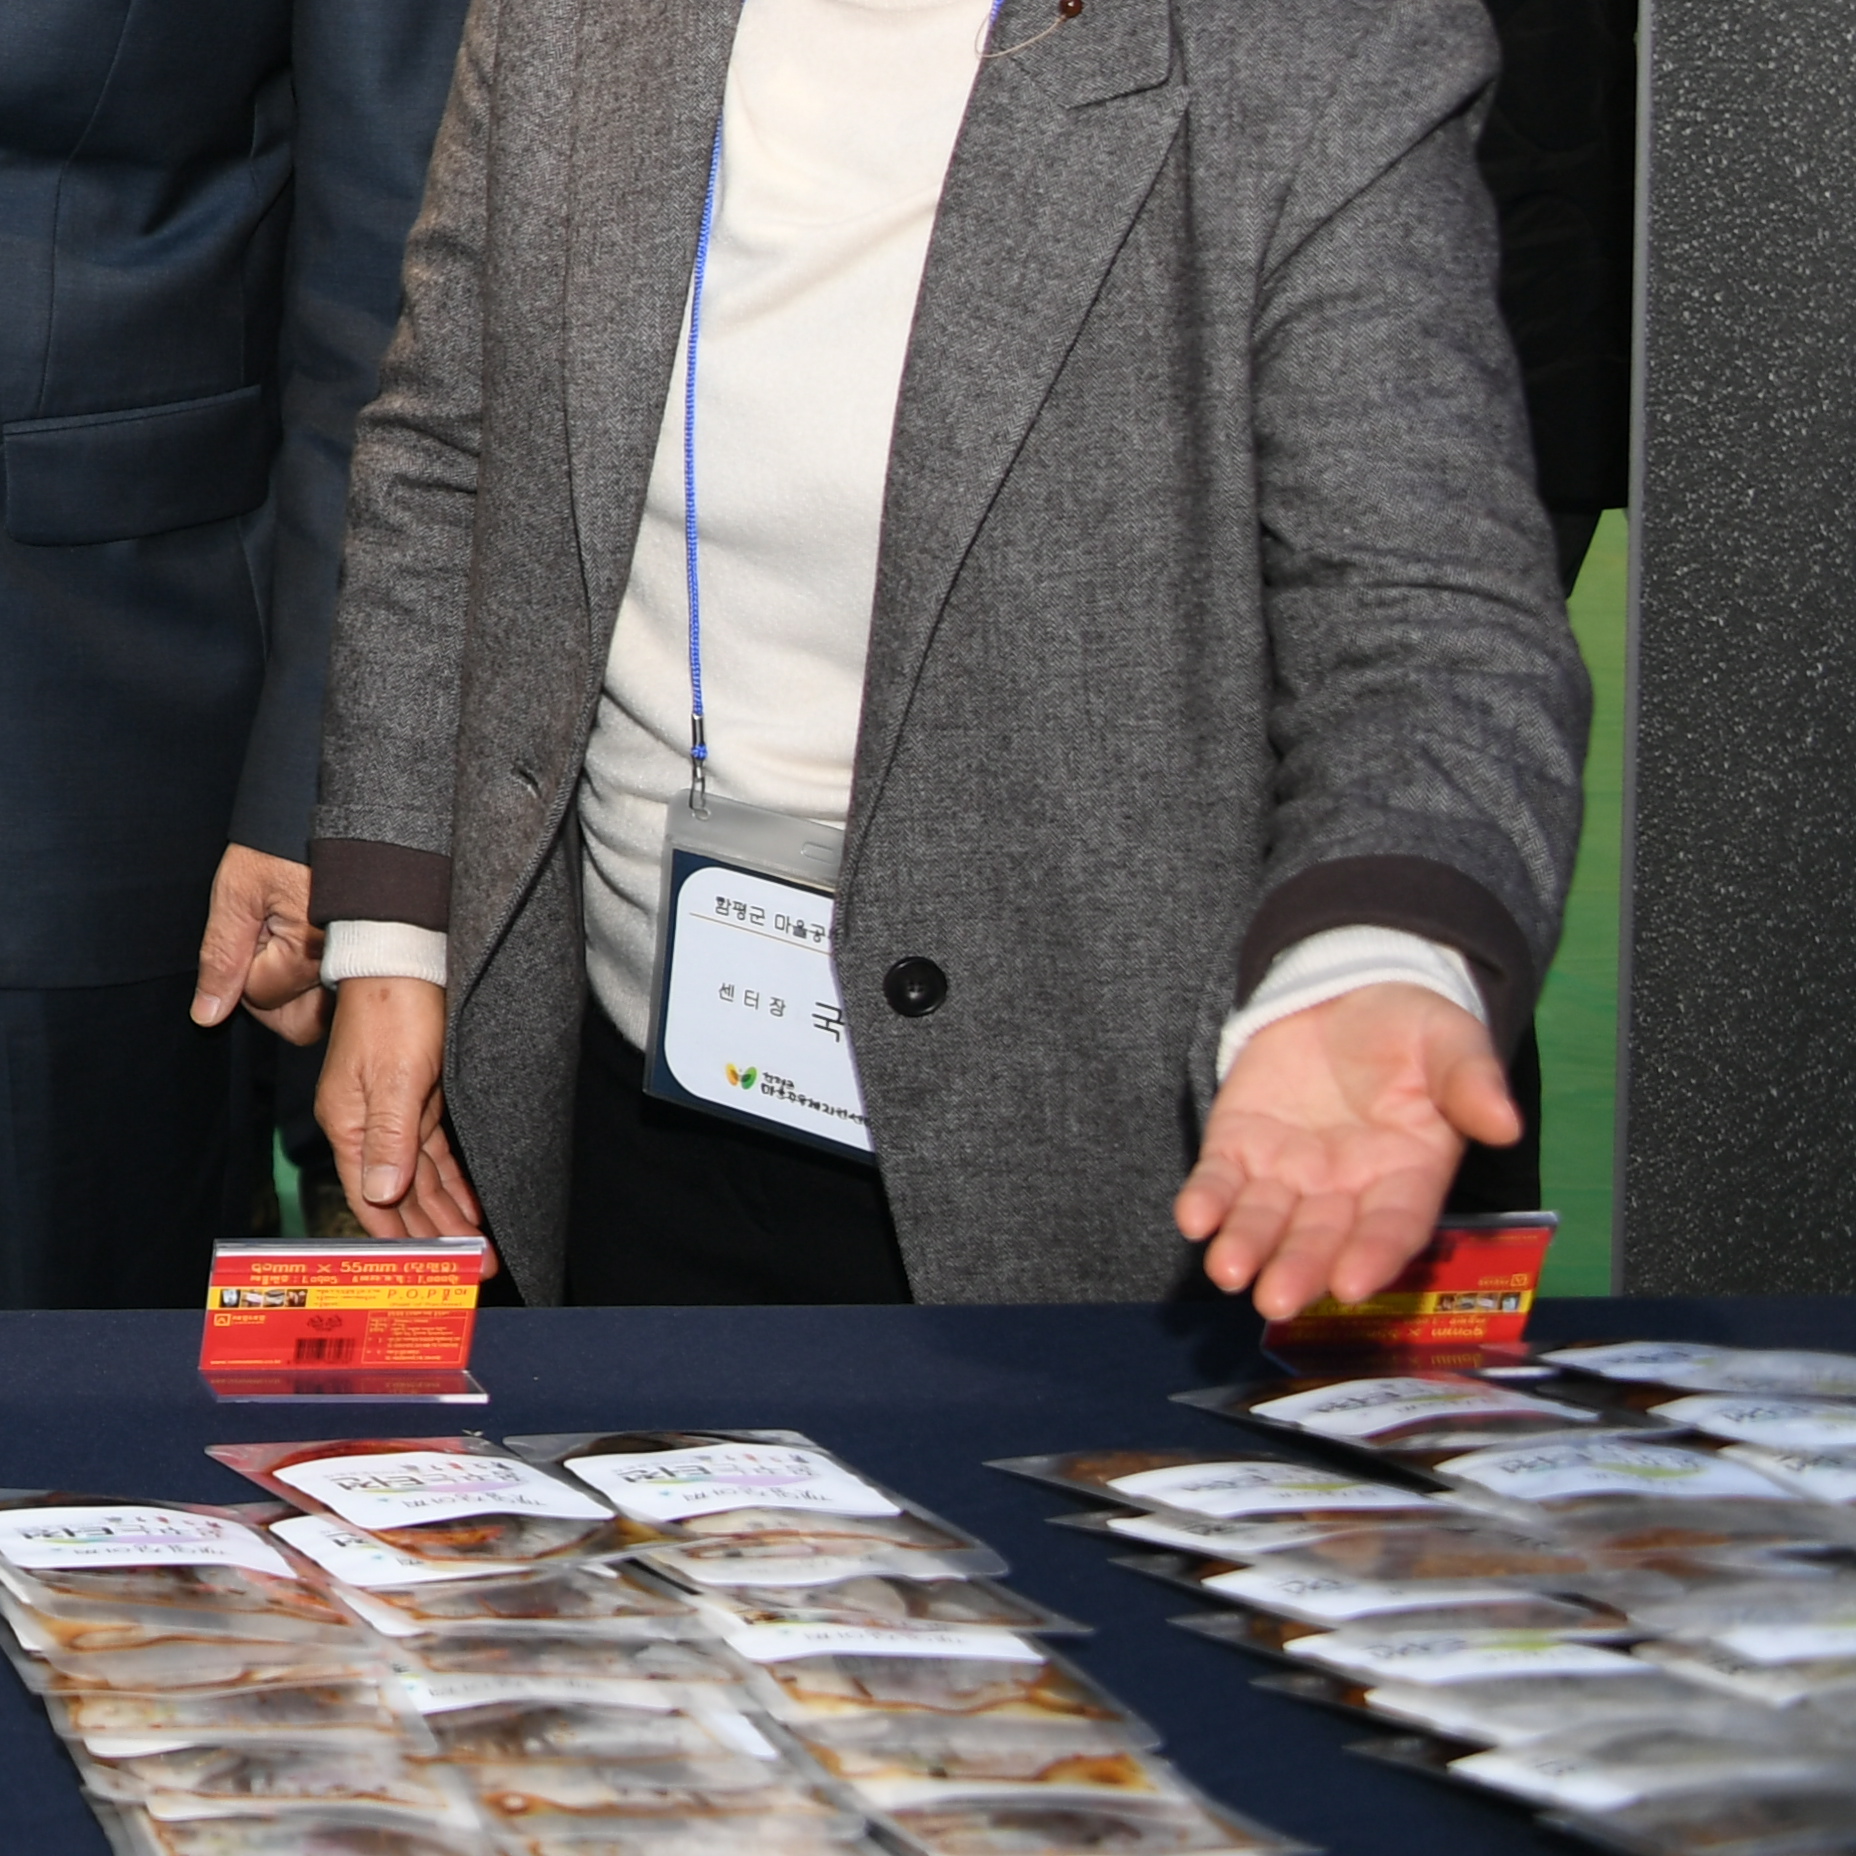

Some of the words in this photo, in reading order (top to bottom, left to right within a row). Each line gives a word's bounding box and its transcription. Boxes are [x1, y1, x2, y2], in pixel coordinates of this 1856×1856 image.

[715, 896, 766, 927] 함평군
[774, 913, 833, 943] 마을공
[811, 1001, 846, 1043] 국
[250, 1262, 307, 1274] 90mm
[340, 1260, 398, 1274] 55mm
